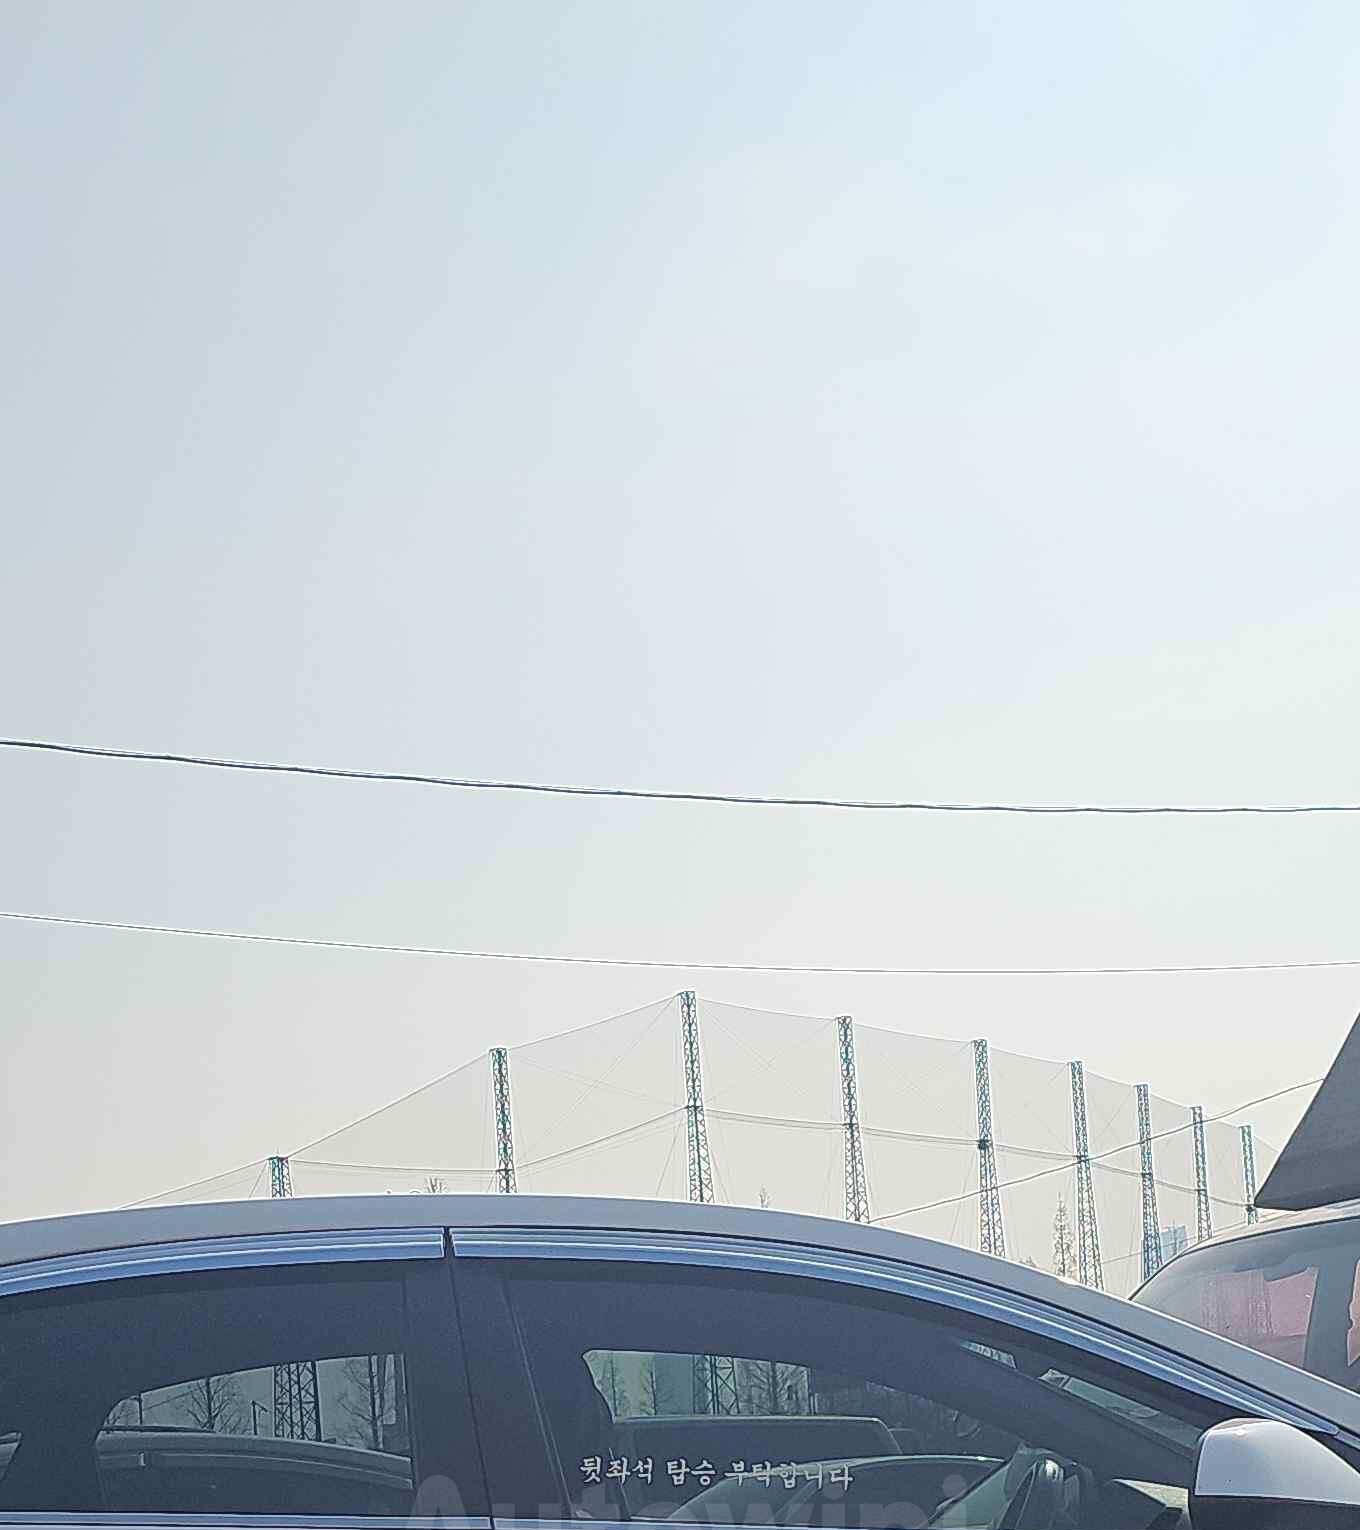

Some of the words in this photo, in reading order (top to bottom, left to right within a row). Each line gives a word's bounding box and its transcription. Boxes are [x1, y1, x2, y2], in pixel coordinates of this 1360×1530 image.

[580, 1455, 653, 1484] 뒷좌석
[667, 1458, 717, 1487] 탑승
[724, 1460, 854, 1491] 부탁합니다
